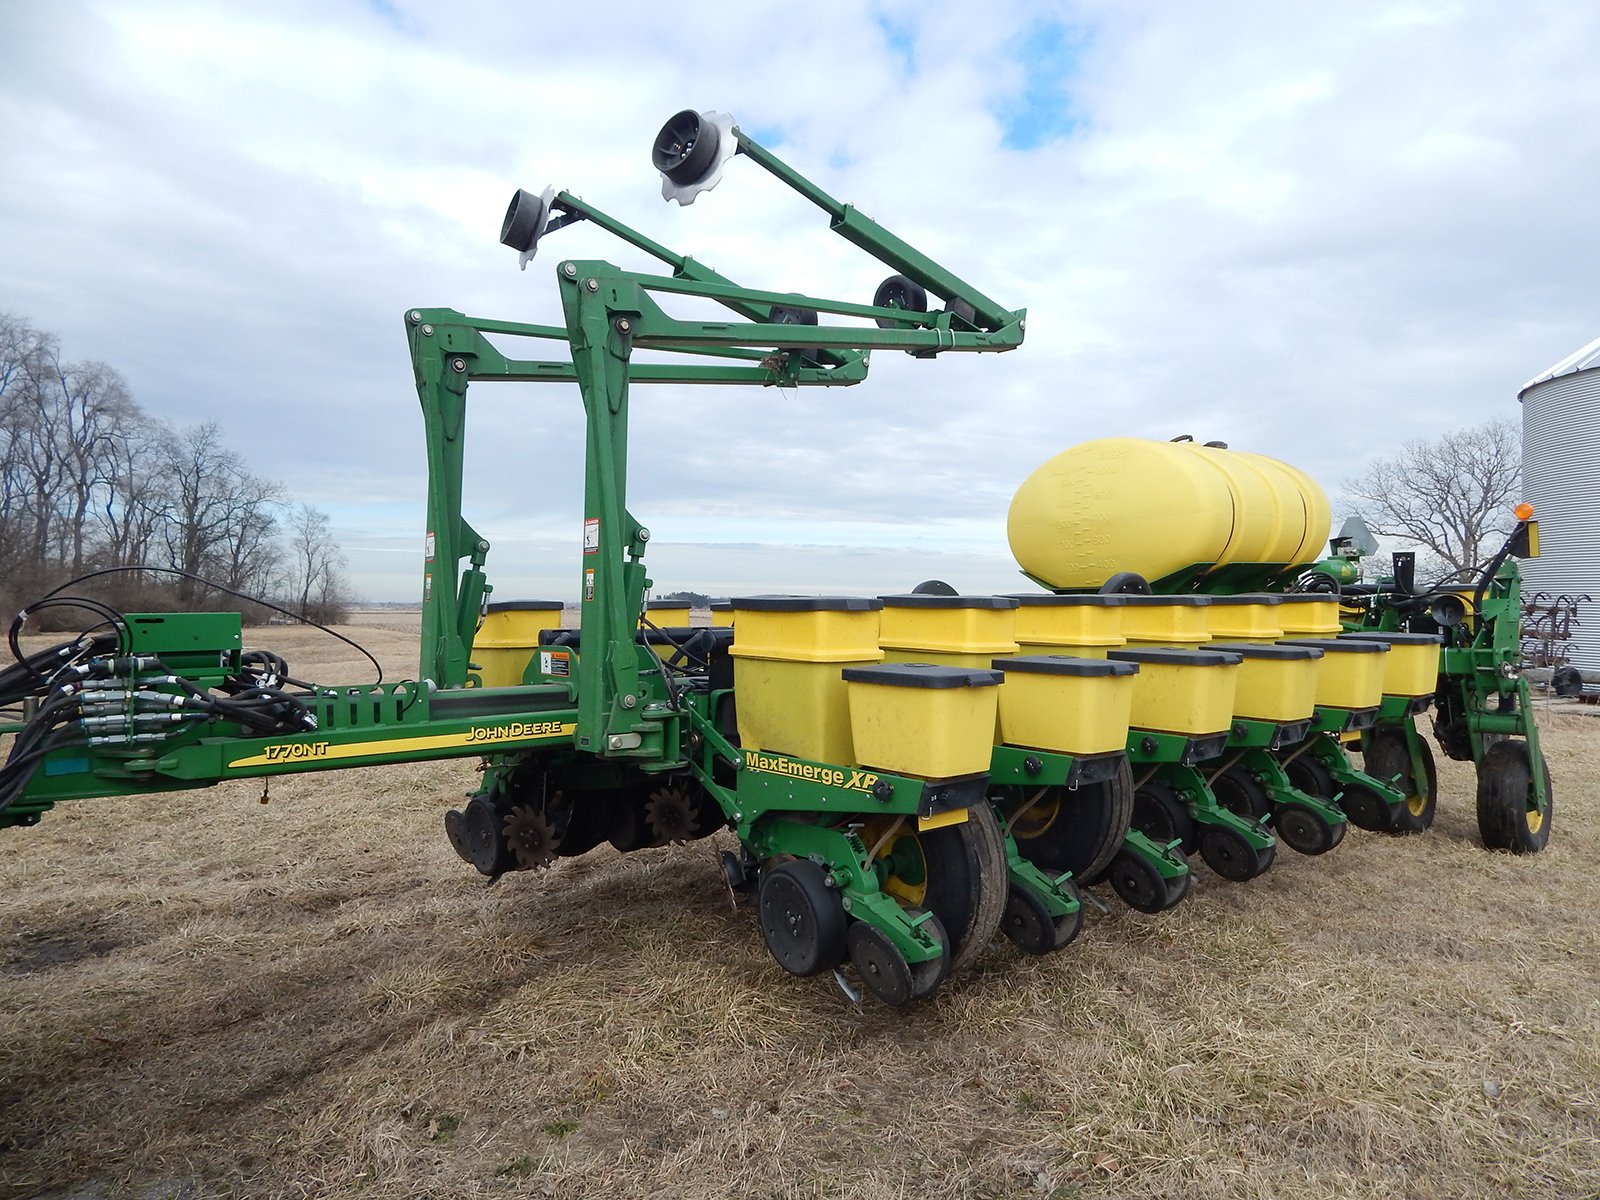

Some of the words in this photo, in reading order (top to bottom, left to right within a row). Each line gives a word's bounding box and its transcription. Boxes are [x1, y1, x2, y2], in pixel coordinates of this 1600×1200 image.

[465, 725, 509, 741] JOHN
[510, 721, 561, 736] DEERE
[263, 741, 330, 759] 1770NT
[746, 751, 844, 785] MaxEmerge
[843, 770, 879, 789] XP
